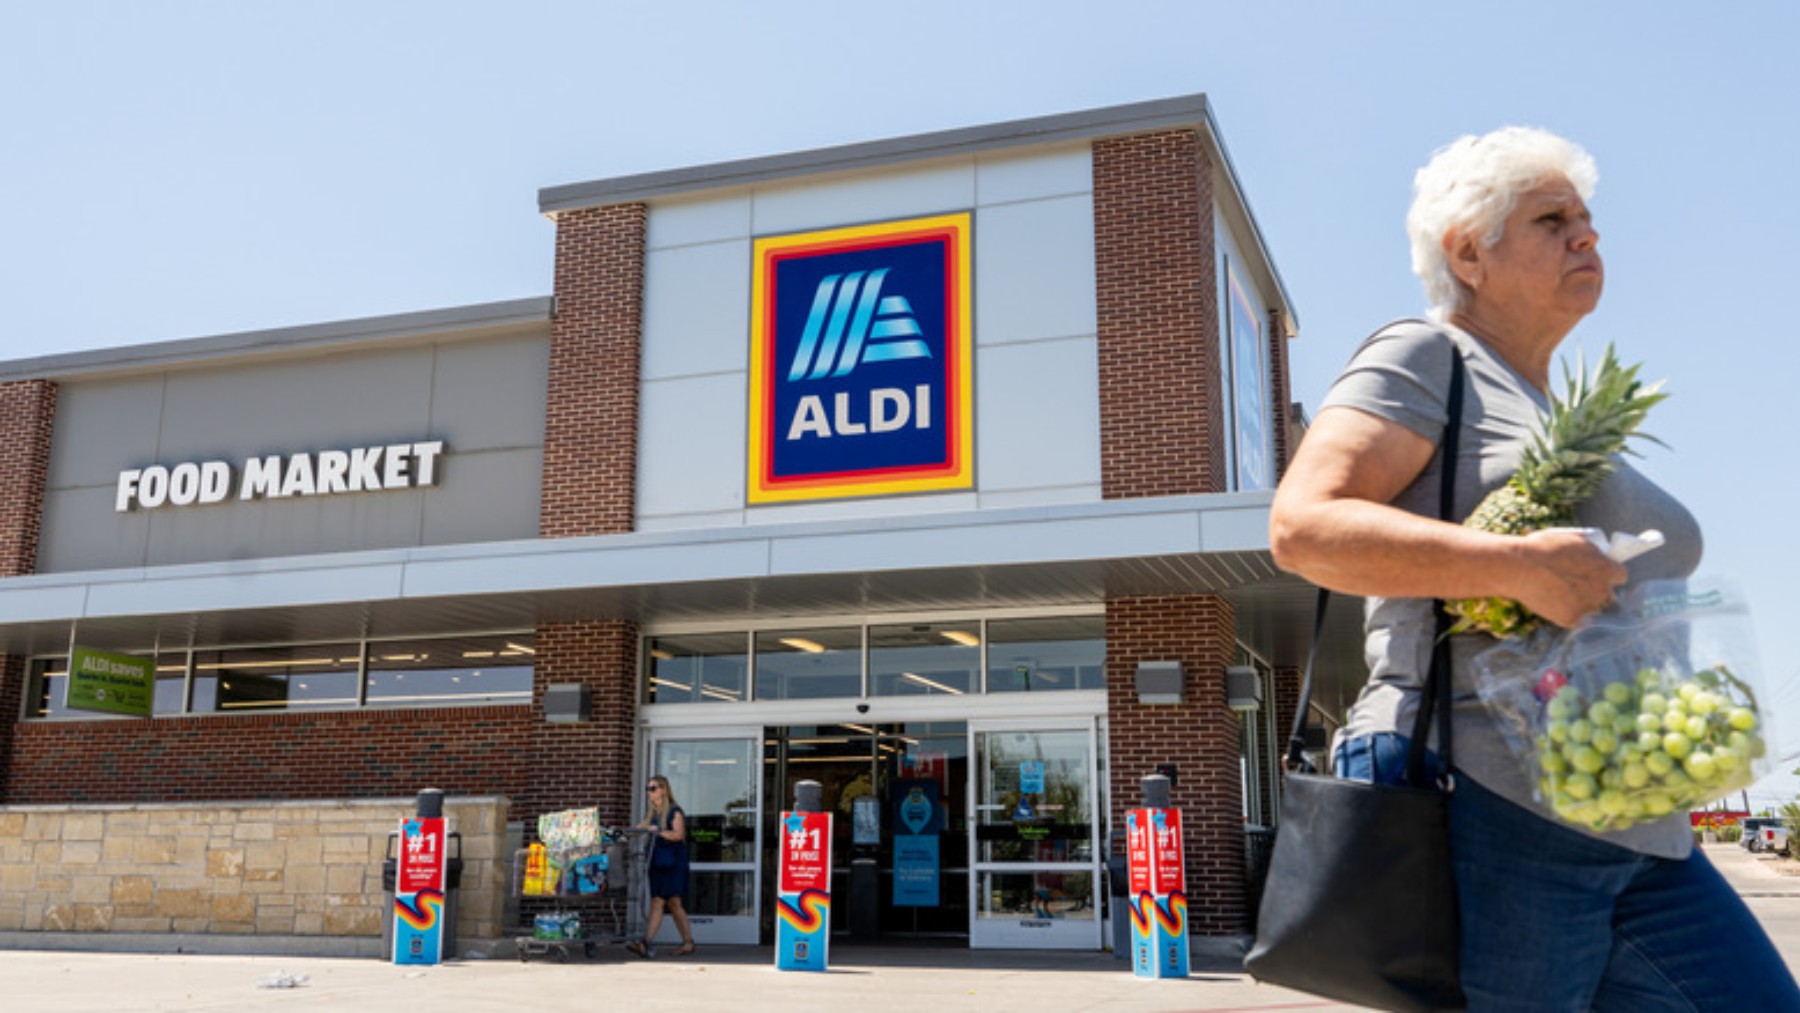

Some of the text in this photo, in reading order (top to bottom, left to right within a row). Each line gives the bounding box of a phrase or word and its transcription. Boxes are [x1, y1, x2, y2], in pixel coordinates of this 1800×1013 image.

[786, 384, 931, 441] ALDI
[115, 441, 443, 512] FOOD MARKET
[82, 656, 109, 672] ALDI
[407, 832, 436, 853] #1
[789, 828, 821, 849] #1
[1156, 826, 1178, 849] #1
